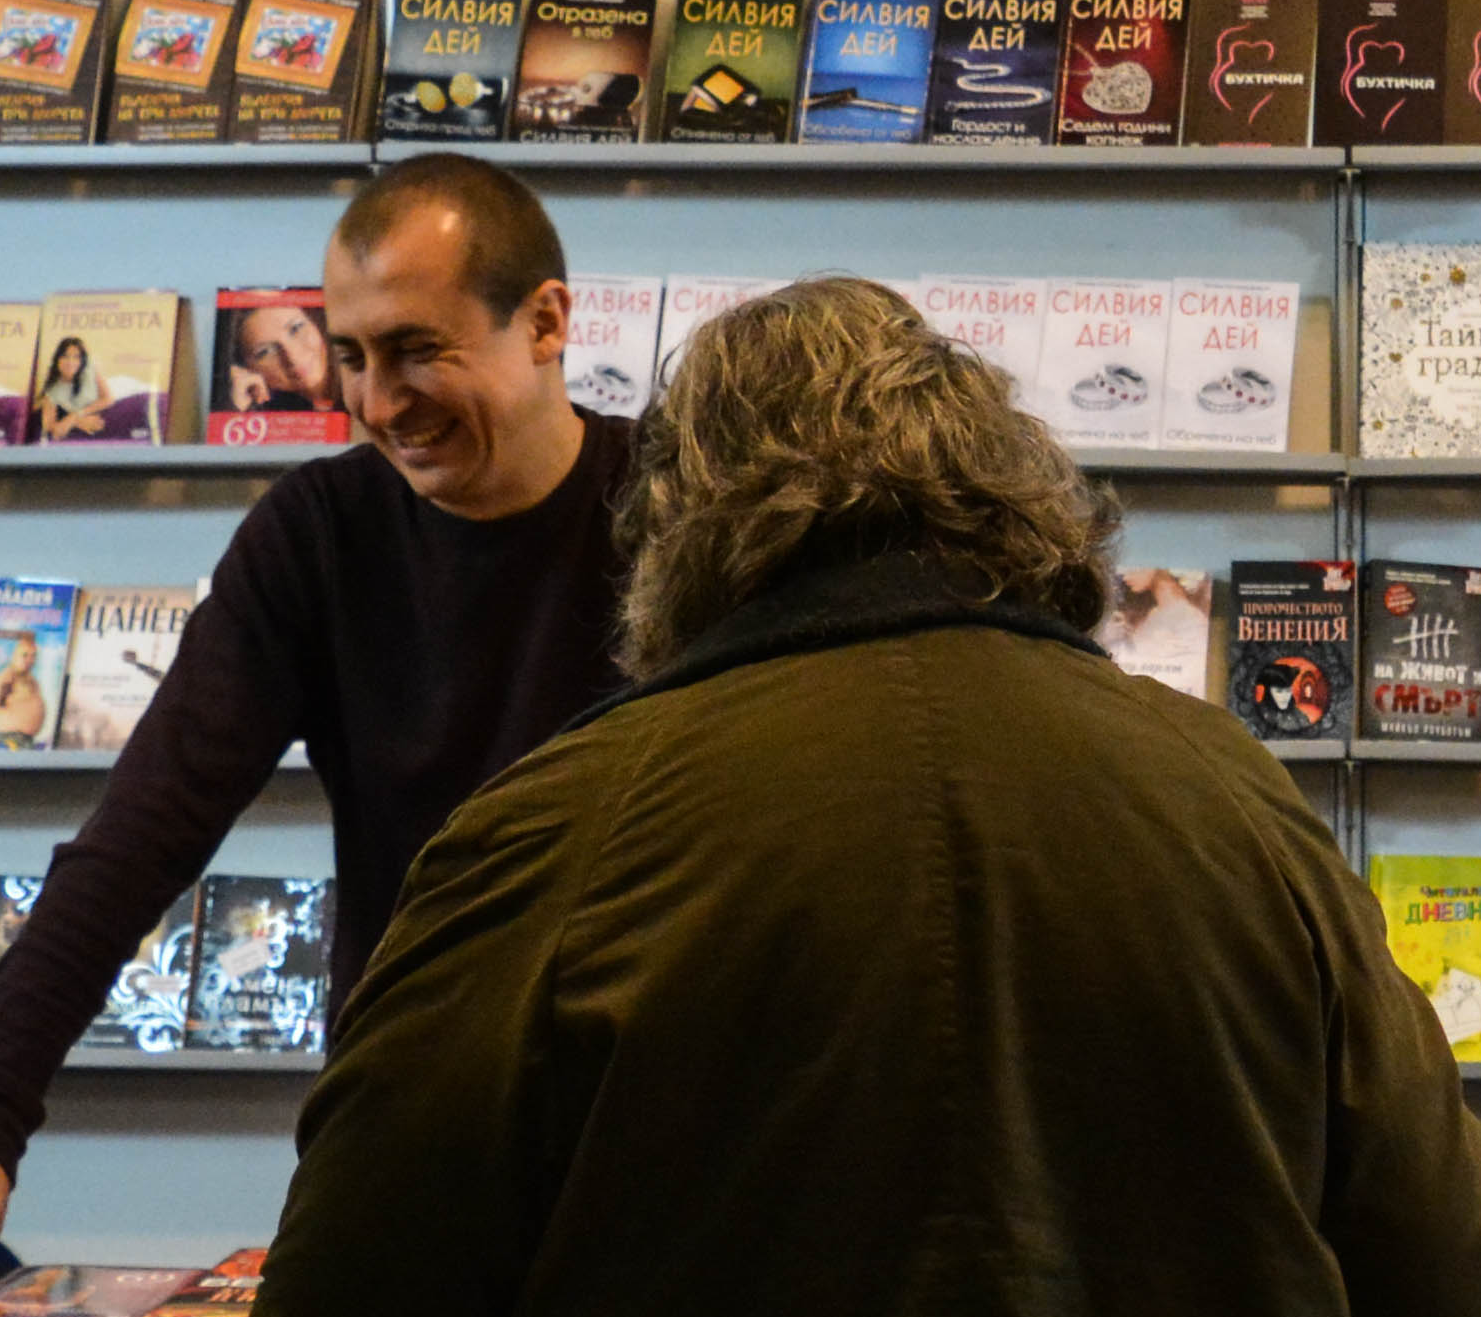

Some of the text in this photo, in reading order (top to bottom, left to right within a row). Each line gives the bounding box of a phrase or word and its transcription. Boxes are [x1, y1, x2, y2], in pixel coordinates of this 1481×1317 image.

[537, 2, 648, 26] Отразена
[424, 28, 481, 56] ДЕЙ
[706, 30, 762, 58] ДЕЙ
[840, 31, 898, 57] ДЕЙ
[969, 25, 1025, 51] ДЕЙ
[1095, 23, 1152, 51] ДЕЙ
[1225, 72, 1303, 86] БУХТИЧКА
[1356, 76, 1435, 90] БУХТИЧКА
[1063, 120, 1114, 134] Седем
[926, 288, 1037, 317] СИЛВИЯ
[1052, 290, 1163, 317] СИЛВИЯ
[1179, 292, 1290, 319] СИЛВИЯ
[52, 311, 163, 332] ЛЮБОВТА
[1075, 319, 1132, 348] ДЕЙ
[1203, 323, 1258, 350] ДЕЙ
[223, 415, 268, 444] 69
[83, 604, 188, 636] ЦАНЕВ
[1243, 602, 1343, 616] ПРОРОЧЕСТВОТО
[1238, 616, 1348, 645] ВЕНЕЦИЯ
[1374, 661, 1468, 685] НА ЖИВОТ
